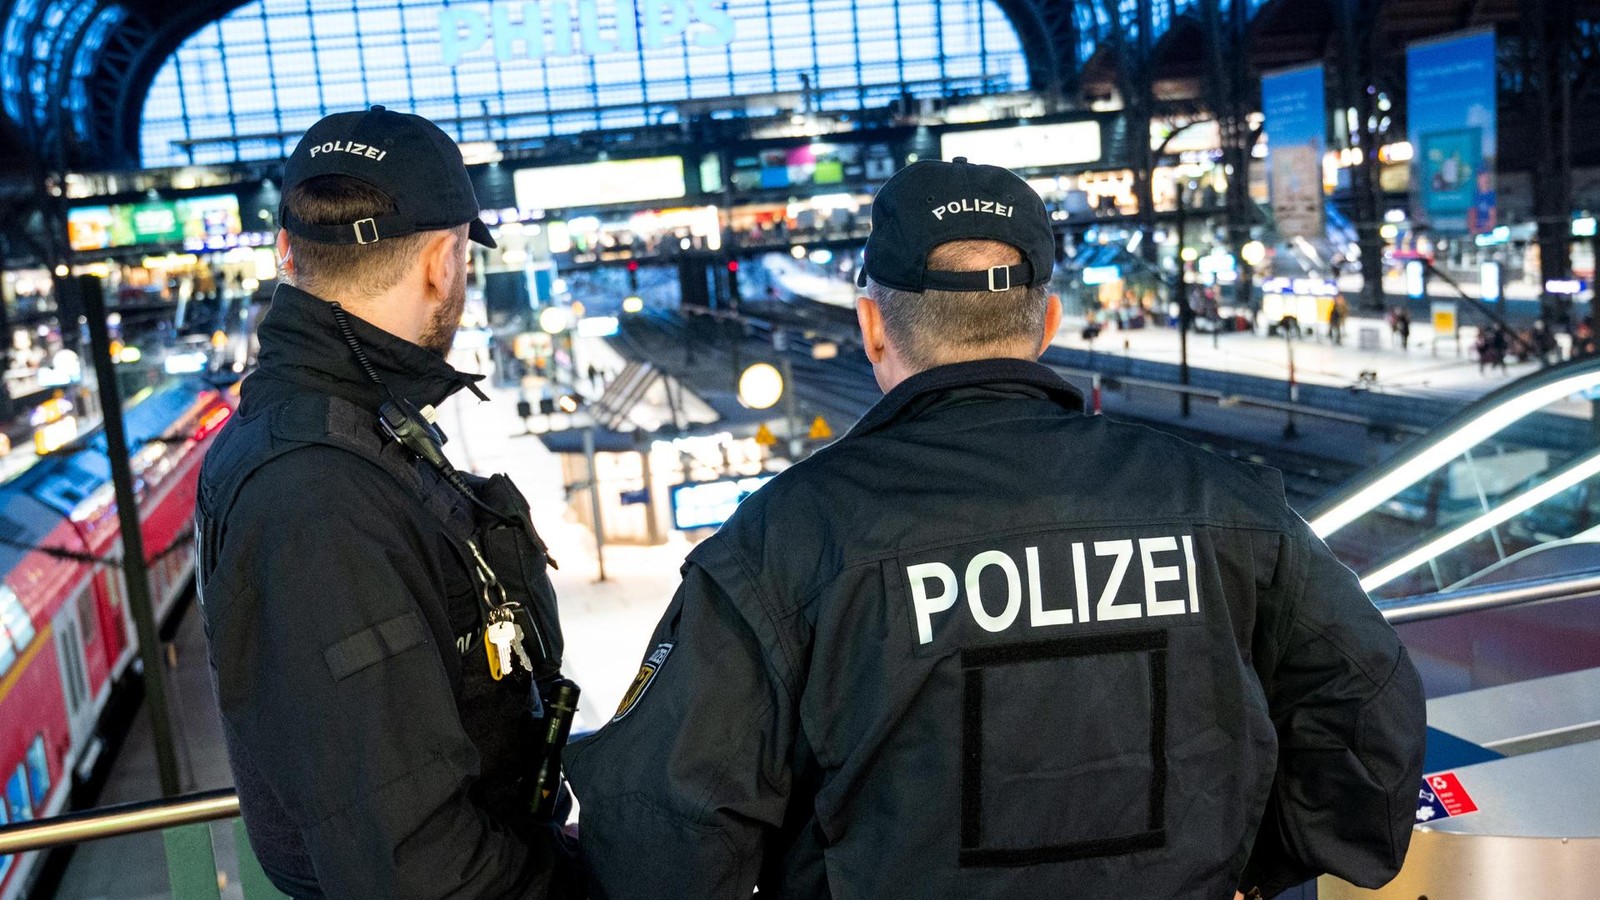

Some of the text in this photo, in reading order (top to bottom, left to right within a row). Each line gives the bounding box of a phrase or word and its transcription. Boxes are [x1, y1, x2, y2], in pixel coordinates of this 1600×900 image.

[439, 0, 736, 66] PHILIPS
[309, 140, 387, 162] POLIZEI
[931, 198, 1014, 221] POLIZEI
[906, 534, 1201, 645] POLIZEI
